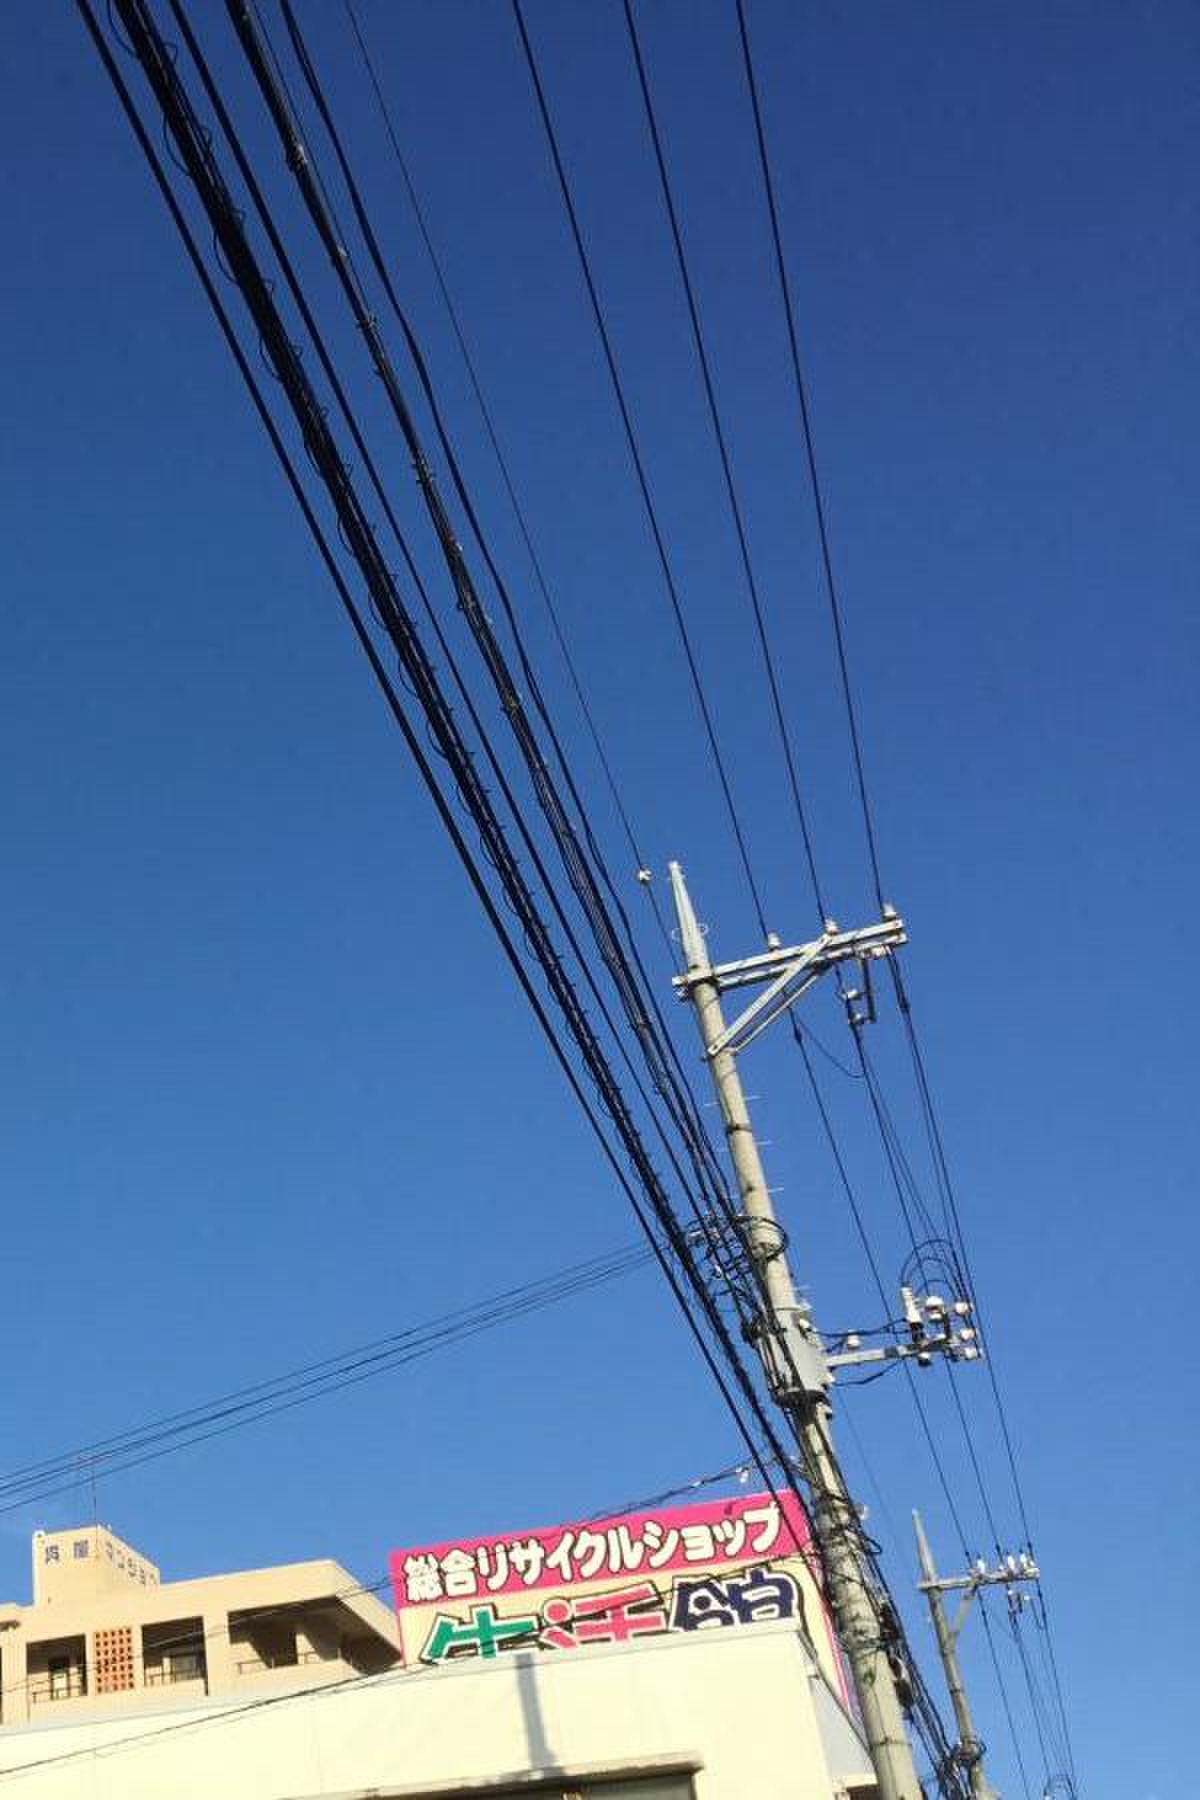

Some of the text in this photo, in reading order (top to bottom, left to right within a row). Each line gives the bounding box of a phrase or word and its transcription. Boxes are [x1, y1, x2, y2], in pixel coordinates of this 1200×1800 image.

[403, 1501, 783, 1603] 総合リサイクルショップ
